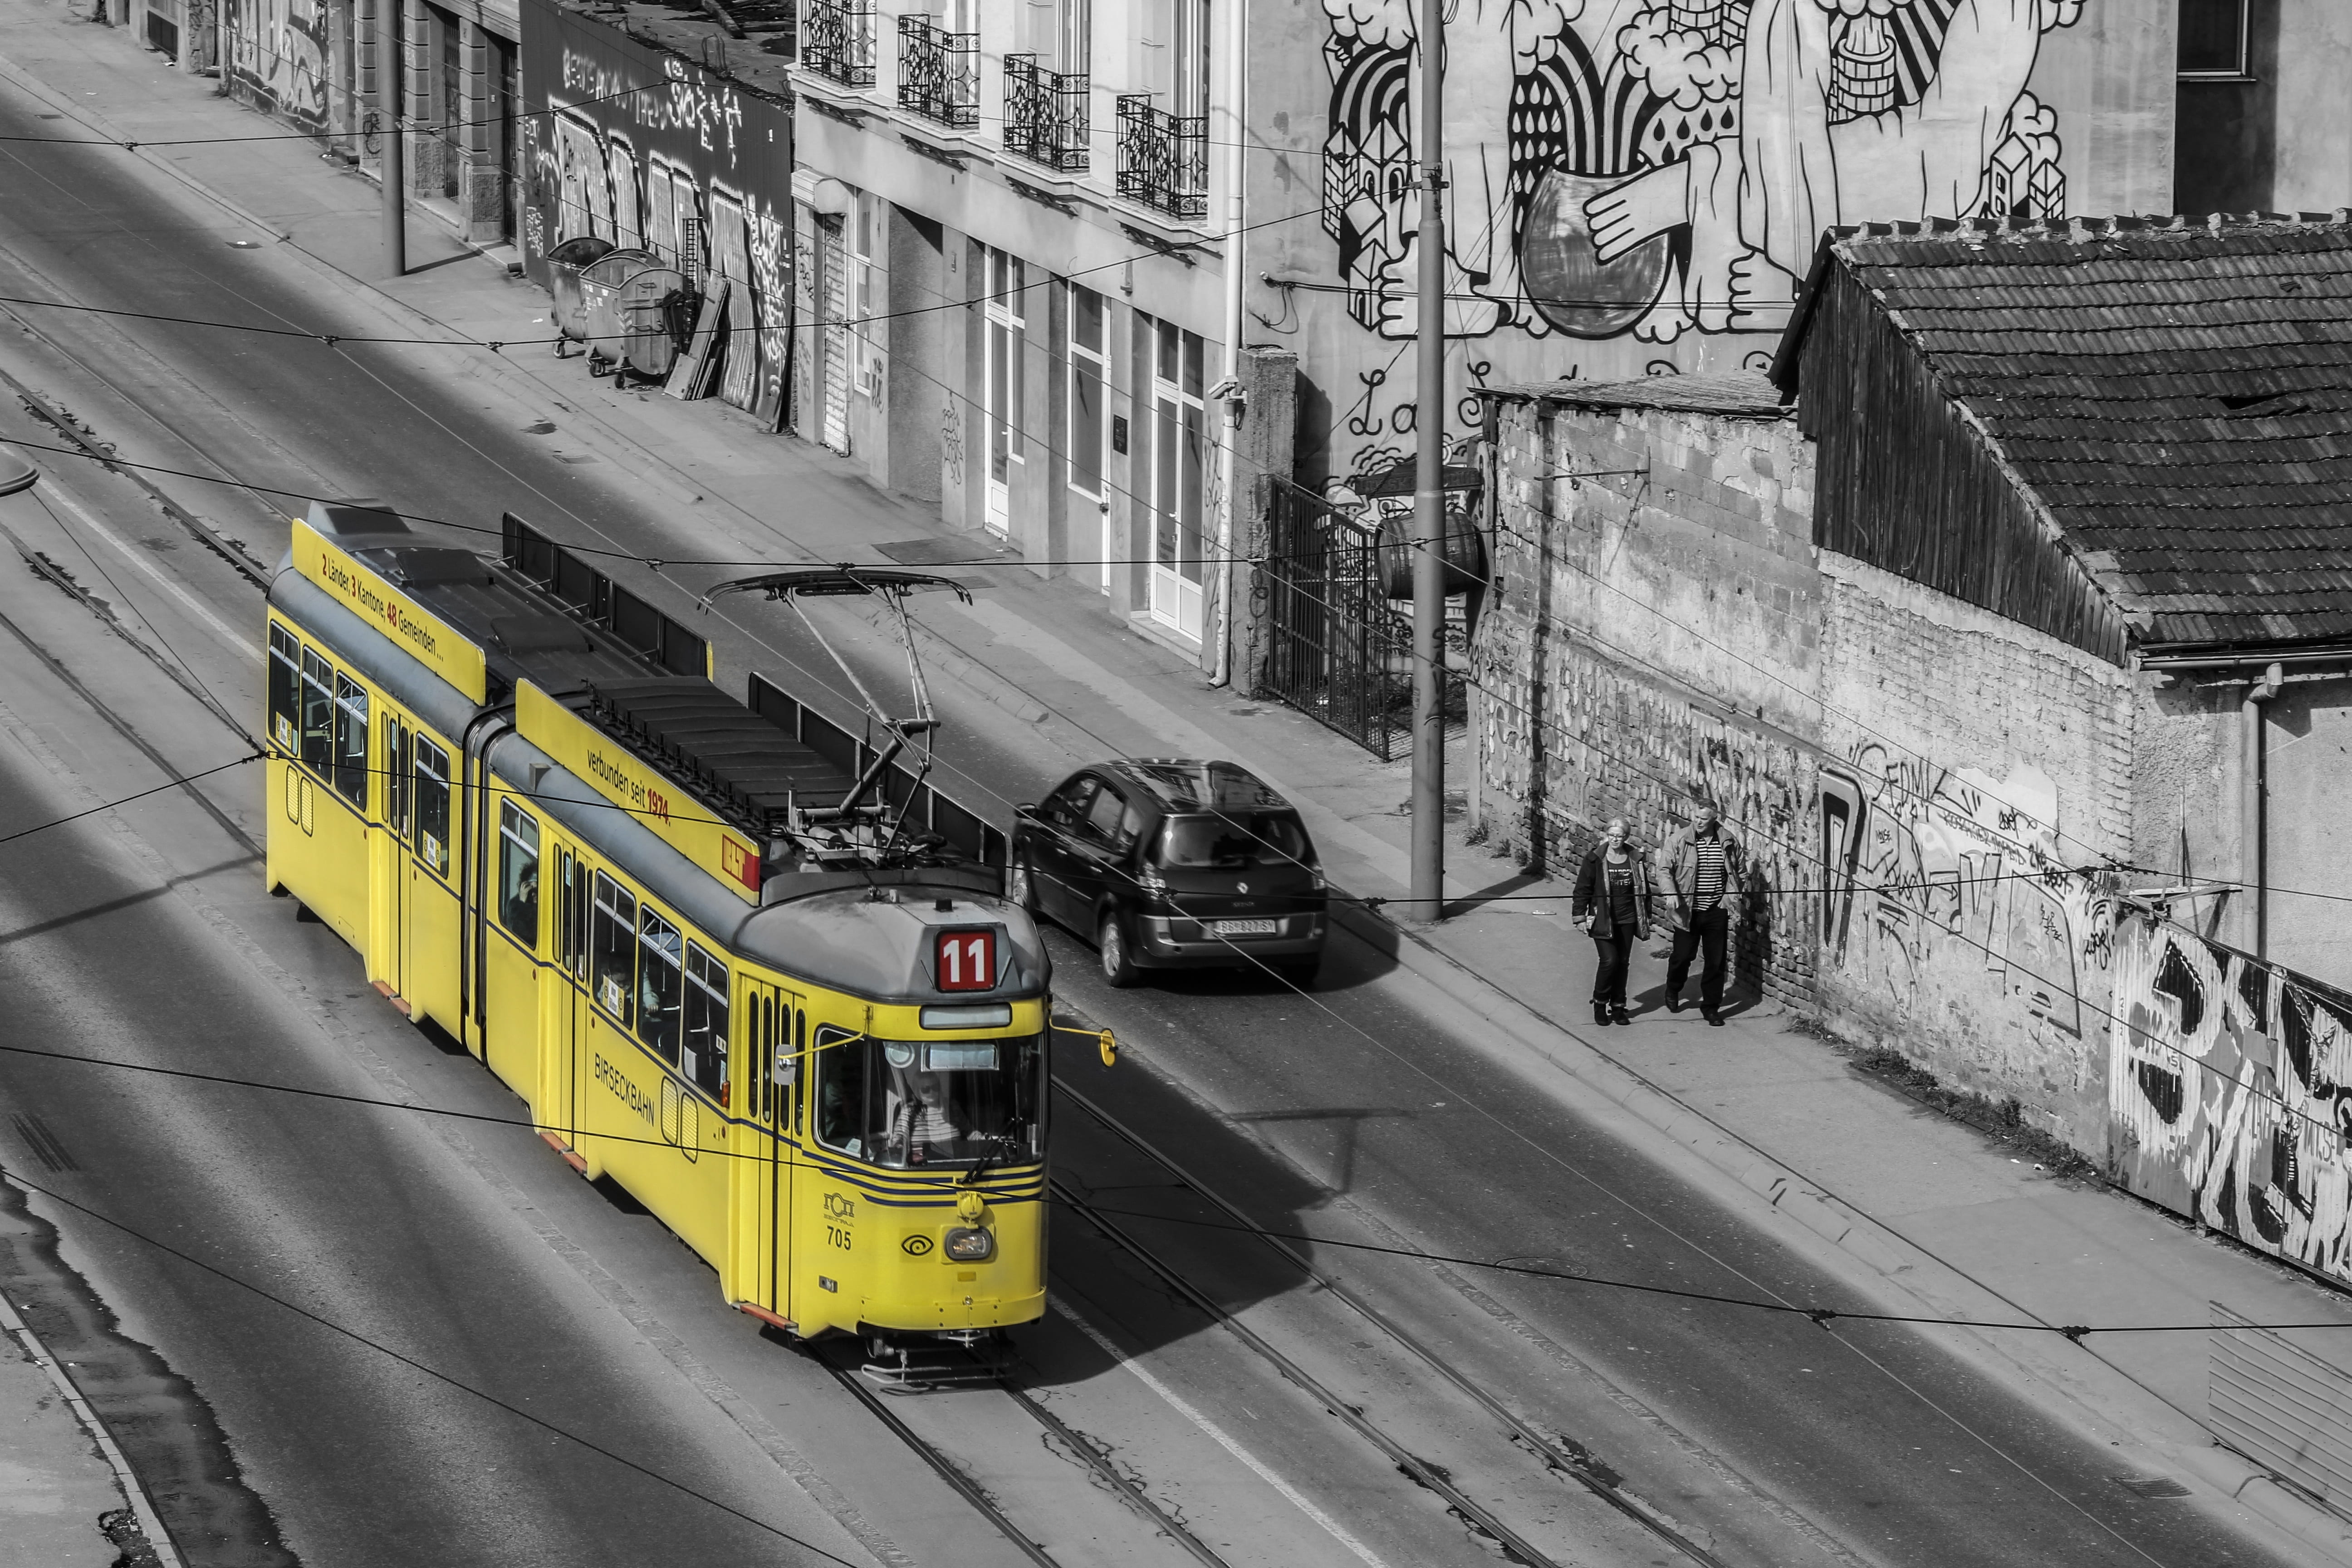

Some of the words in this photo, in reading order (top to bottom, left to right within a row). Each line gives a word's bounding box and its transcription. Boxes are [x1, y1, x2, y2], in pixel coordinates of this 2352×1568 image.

[323, 554, 327, 577] 2
[328, 558, 350, 597] Länder,
[351, 575, 356, 598] 3
[358, 578, 386, 622] Kantone,
[387, 602, 397, 627] 48
[587, 749, 629, 797] verbunden
[631, 781, 646, 808] seit
[724, 835, 745, 881] BLT
[943, 939, 985, 983] 11
[595, 1052, 655, 1127] BIRSECKBAHN
[827, 1225, 851, 1251] 705
